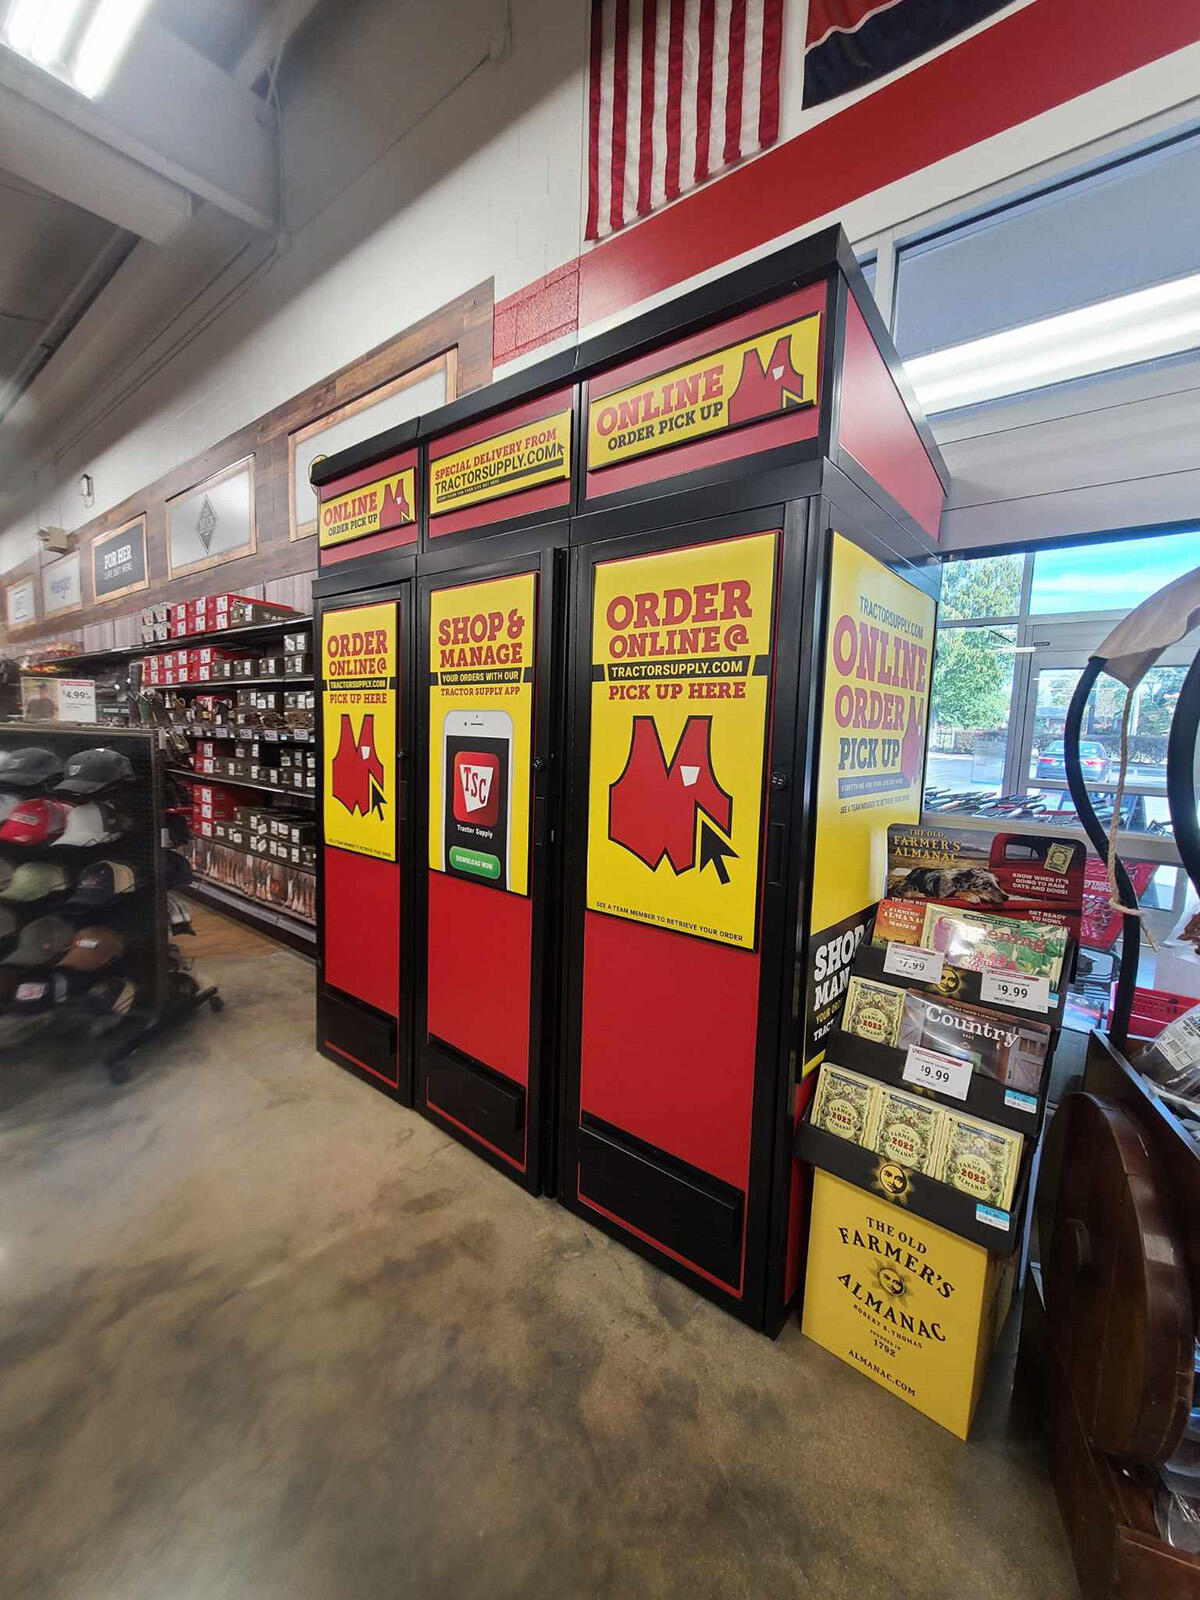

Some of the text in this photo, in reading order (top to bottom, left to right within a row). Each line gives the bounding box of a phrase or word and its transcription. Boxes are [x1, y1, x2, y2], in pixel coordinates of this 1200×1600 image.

[596, 365, 724, 436] ONLINE
[608, 400, 724, 451] ORDER PICK UP
[435, 428, 557, 480] SPECIAL DELIVERY FROM
[435, 443, 557, 495] TRACTORSUPPLY.COM
[323, 491, 378, 527] ONLINE
[328, 514, 378, 537] ORDER PICK UP
[104, 544, 132, 570] FOR HER
[606, 579, 752, 631] ORDER
[438, 608, 525, 647] SHOP &
[859, 595, 924, 640] TRACTORSUPPLY.COM
[327, 629, 388, 659] ORDER
[439, 642, 523, 669] MANAGE
[833, 614, 928, 694] ONLINE
[442, 668, 519, 683] YOUR ORDERS WITH OUR
[611, 660, 743, 678] TRACTORSUPPLY.COM
[62, 690, 86, 700] $4.99
[330, 679, 386, 689] TRACTORSUPPLY.COM
[440, 685, 521, 697] TRACTOR SUPPLY APP
[609, 682, 746, 701] PICK UP HERE
[329, 693, 388, 704] PICK UP HERE
[834, 684, 905, 731] ORDER
[838, 736, 900, 772] PICK UP
[463, 767, 486, 805] TSC
[456, 824, 494, 839] Tractor Supply
[908, 827, 944, 839] THE OLD
[893, 835, 962, 852] FARMER'S
[894, 846, 960, 864] ALMANAC
[455, 854, 494, 870] DOWNLOAD NOW
[1015, 878, 1037, 886] GOING
[1046, 887, 1068, 895] DOGS!
[596, 901, 607, 909] SEE
[612, 905, 629, 914] TEAM
[629, 908, 656, 920] MEMBER
[656, 915, 665, 923] TO
[666, 917, 698, 931] RETRIEVE
[699, 925, 718, 936] YOUR
[719, 930, 743, 942] ORDER
[1042, 917, 1062, 925] HOWL
[1043, 911, 1066, 920] READY
[813, 924, 865, 982] SHOP
[998, 983, 1028, 999] $9.99
[925, 1005, 1020, 1048] Country
[920, 1065, 950, 1083] $9.99
[832, 1111, 851, 1125] 2023
[891, 1137, 914, 1152] 2023
[958, 1175, 988, 1192] ALMANAC
[961, 1168, 986, 1185] 2023
[865, 1216, 928, 1255] THE OLD
[838, 1226, 956, 1299] FARMER'S
[837, 1273, 947, 1342] ALMANAC
[853, 1303, 881, 1327] ROBERT
[891, 1329, 923, 1349] THOMAS
[874, 1339, 896, 1358] 1792
[848, 1349, 916, 1397] ALMANAC.COM
